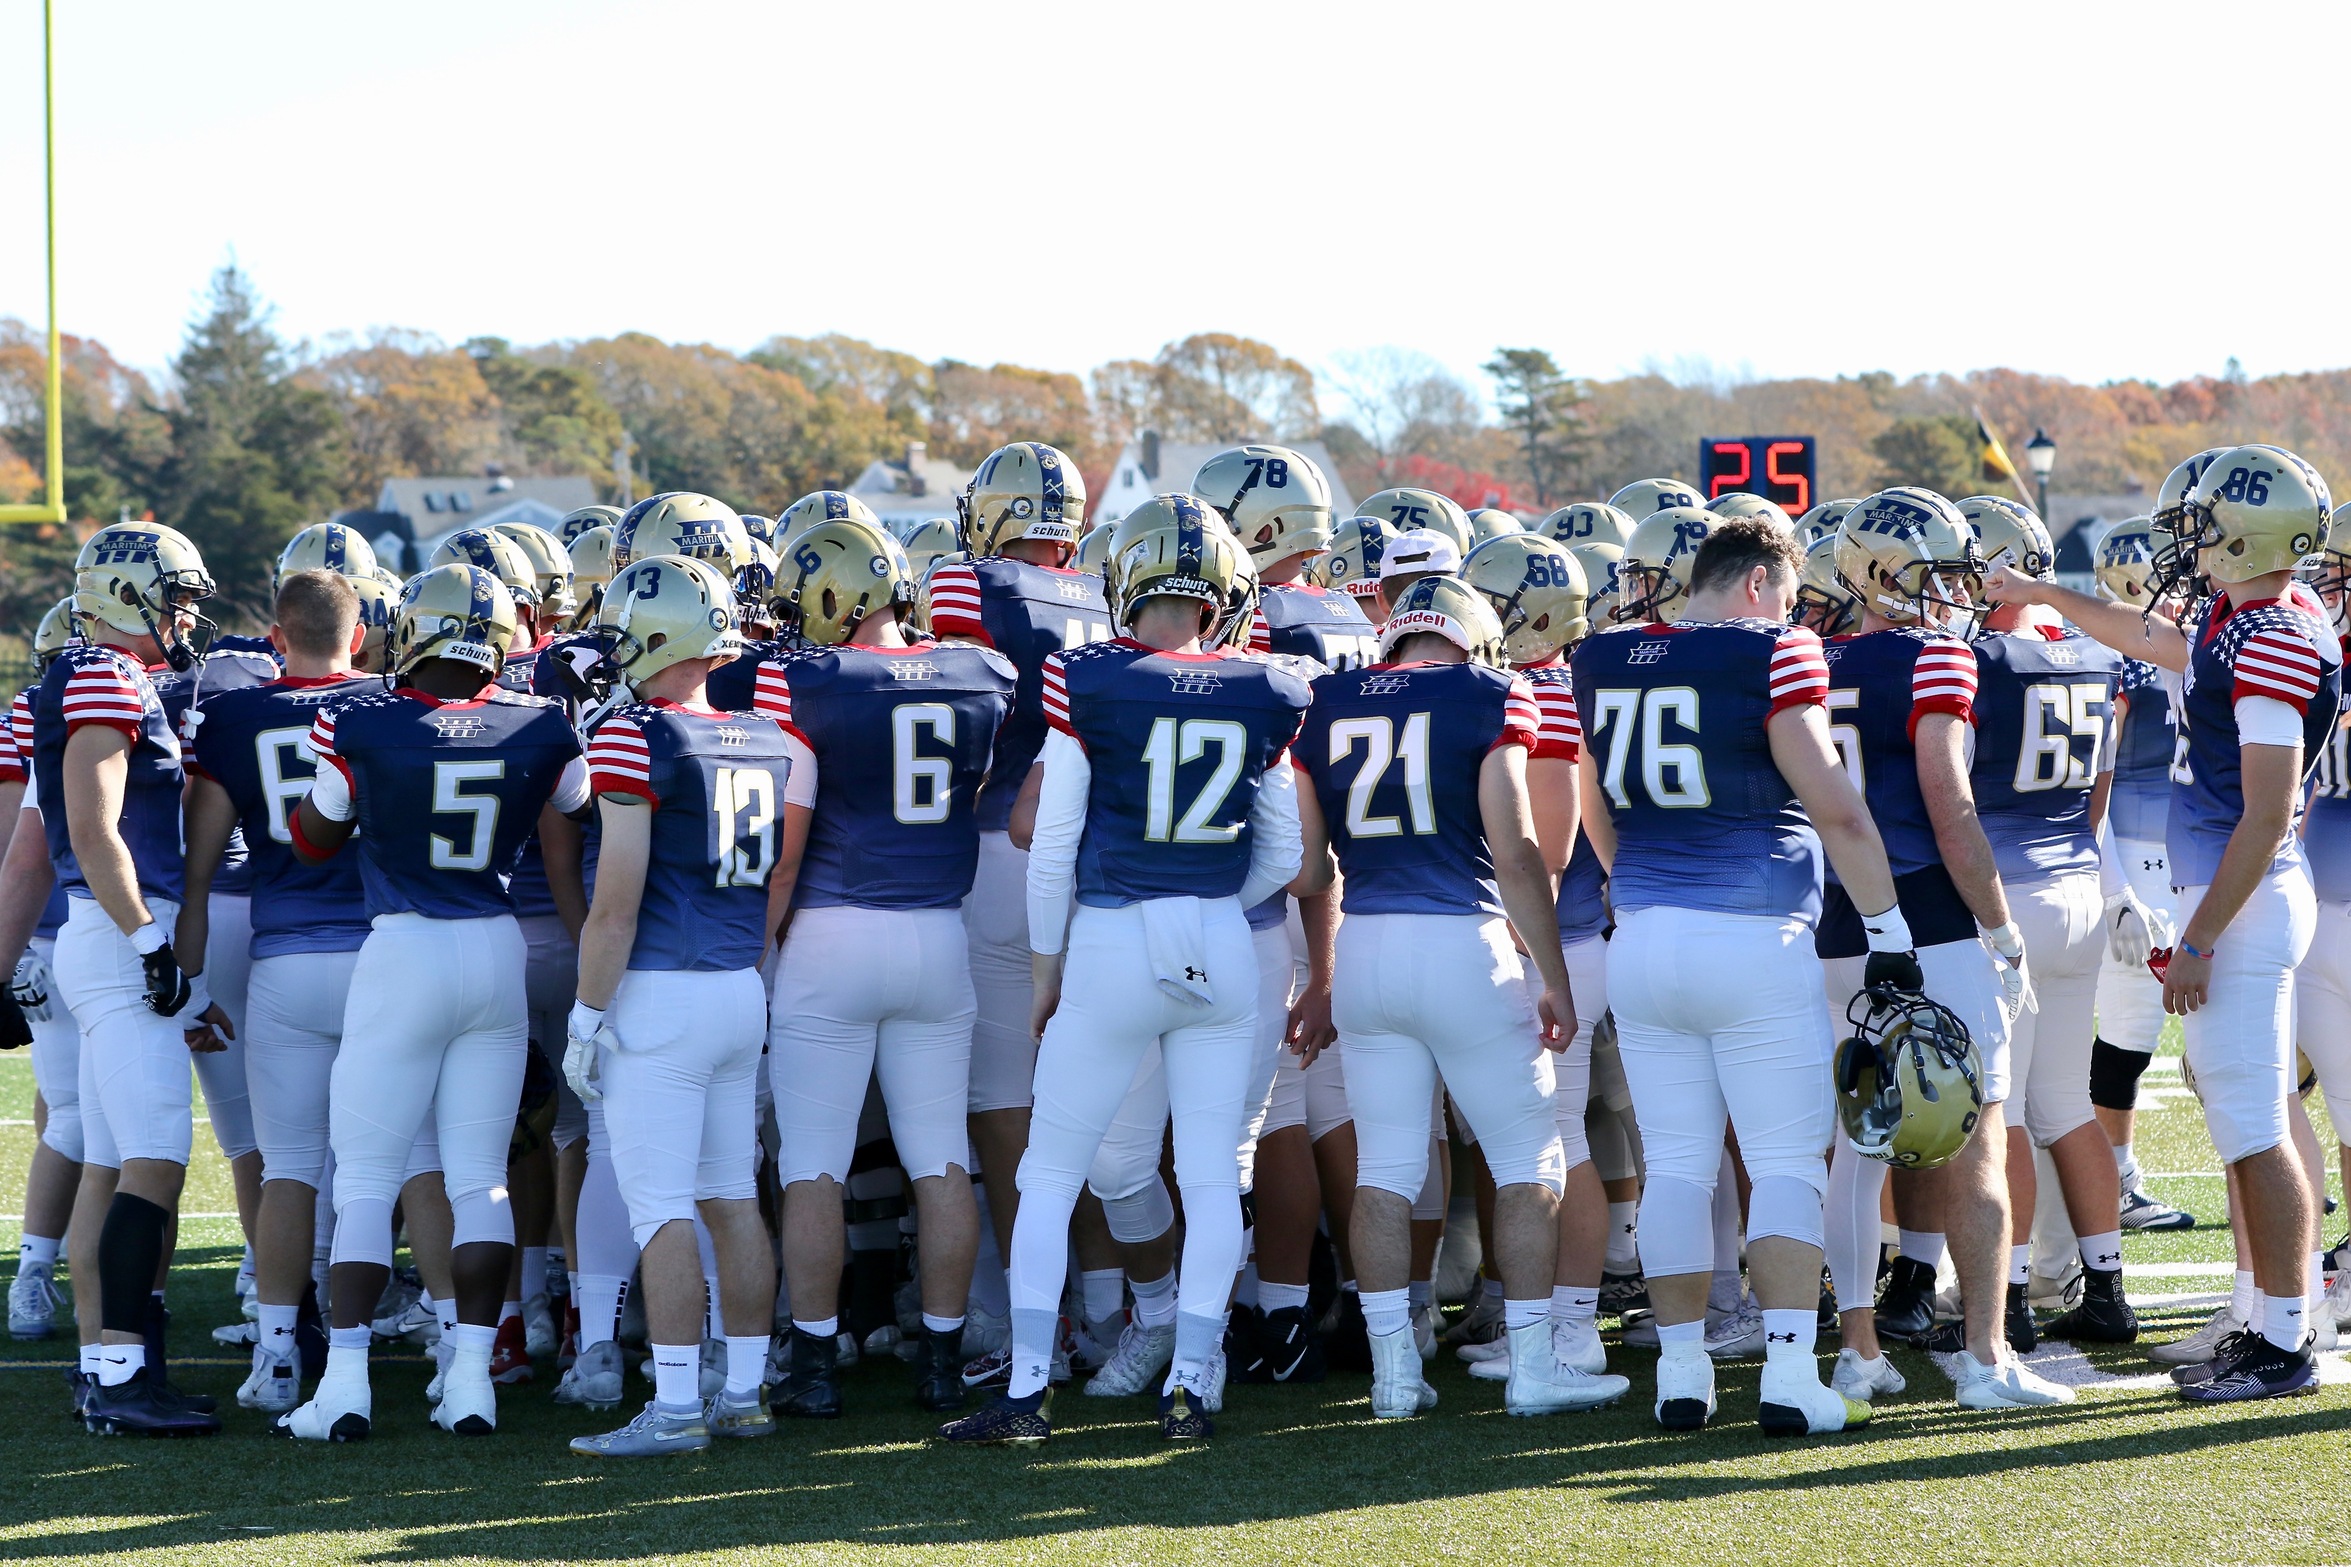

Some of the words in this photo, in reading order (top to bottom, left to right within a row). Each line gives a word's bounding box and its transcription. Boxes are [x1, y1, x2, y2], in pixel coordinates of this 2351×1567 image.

[1244, 459, 1288, 488] 78
[1710, 442, 1809, 515] 25
[2225, 467, 2273, 506] 86
[1032, 526, 1070, 538] schutt
[1391, 506, 1430, 532] 75
[1553, 512, 1594, 541] 93
[682, 535, 720, 546] MARITI
[794, 543, 822, 575] 6
[1526, 554, 1570, 587] 68
[626, 567, 662, 600] 13
[1165, 576, 1210, 591] schutt
[1347, 581, 1382, 594] Ridd
[1390, 611, 1446, 631] Riddell
[450, 643, 491, 663] schutt
[1593, 686, 1711, 809] 76
[2012, 684, 2107, 793] 65
[892, 703, 956, 824] 6
[1329, 712, 1438, 839] 21
[1142, 717, 1247, 844] 12
[430, 759, 505, 872] 5
[713, 768, 775, 888] 13
